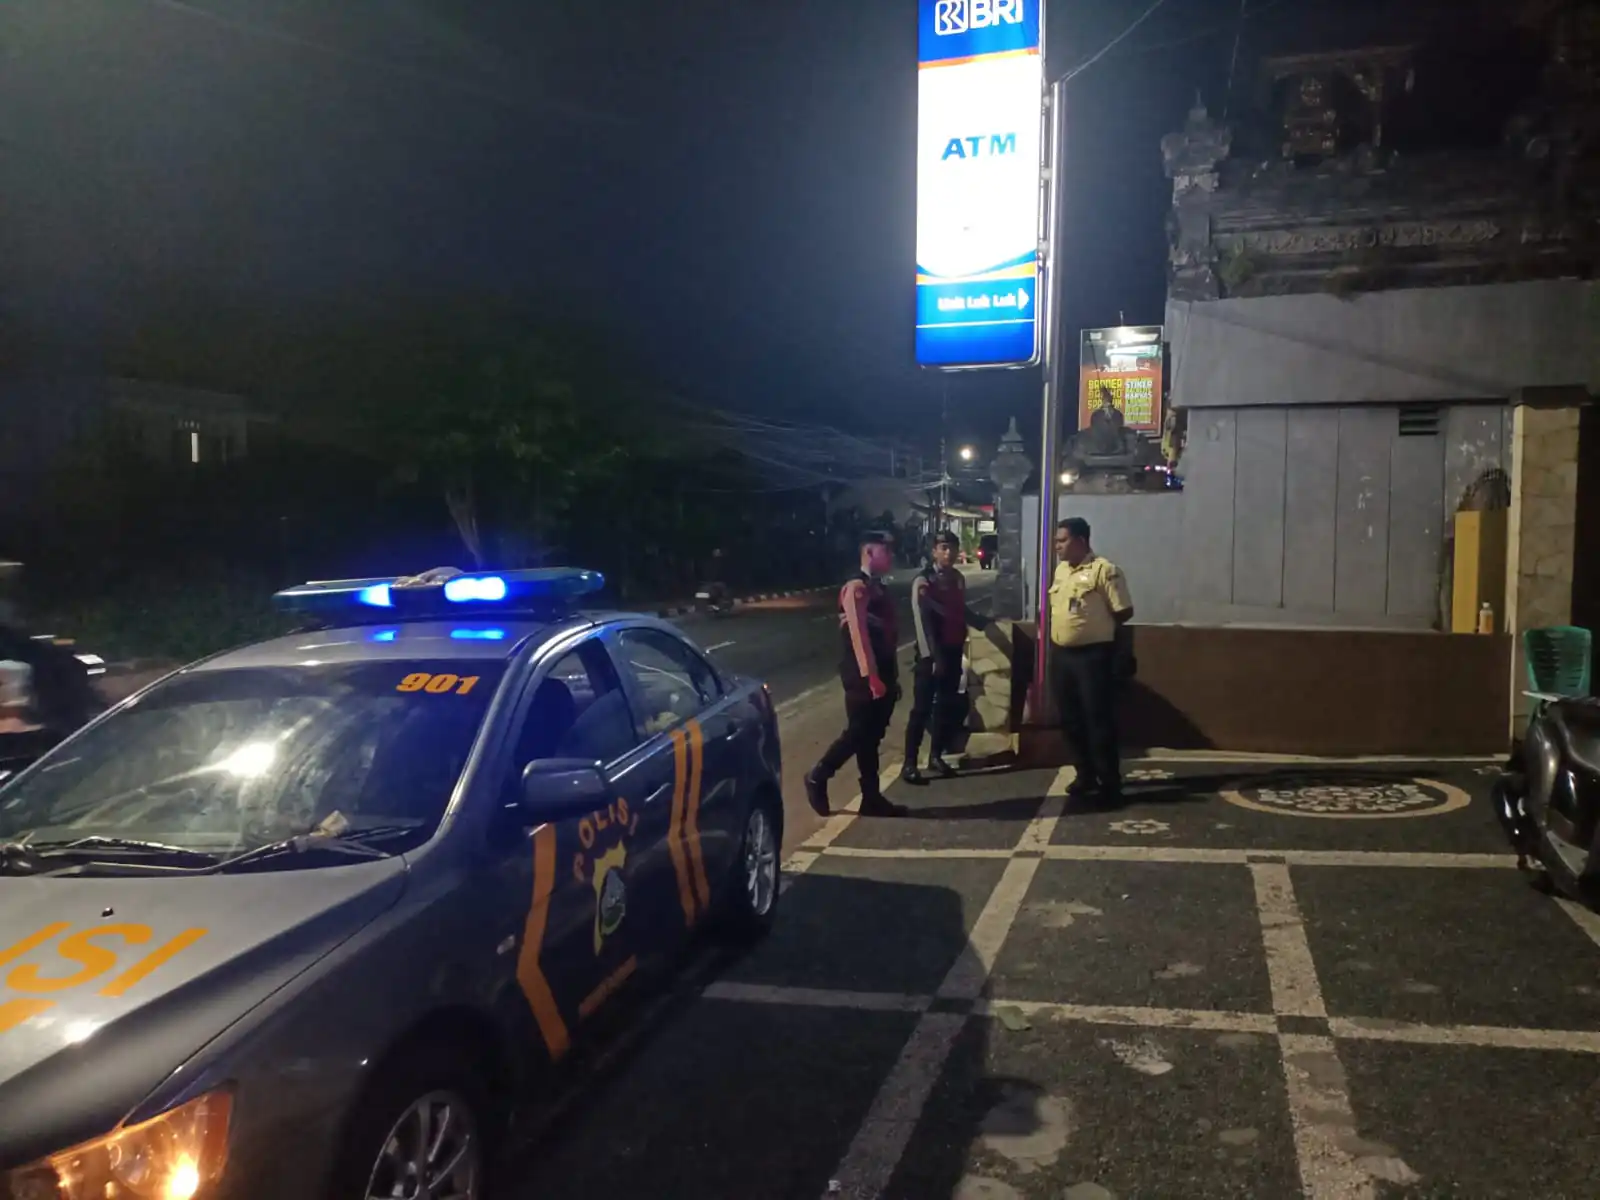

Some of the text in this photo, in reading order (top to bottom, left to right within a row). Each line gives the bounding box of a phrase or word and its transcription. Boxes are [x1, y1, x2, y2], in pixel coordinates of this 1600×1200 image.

[970, 0, 1024, 29] BRI
[941, 132, 1016, 161] ATM
[396, 672, 480, 694] 901
[573, 797, 640, 882] POLISI
